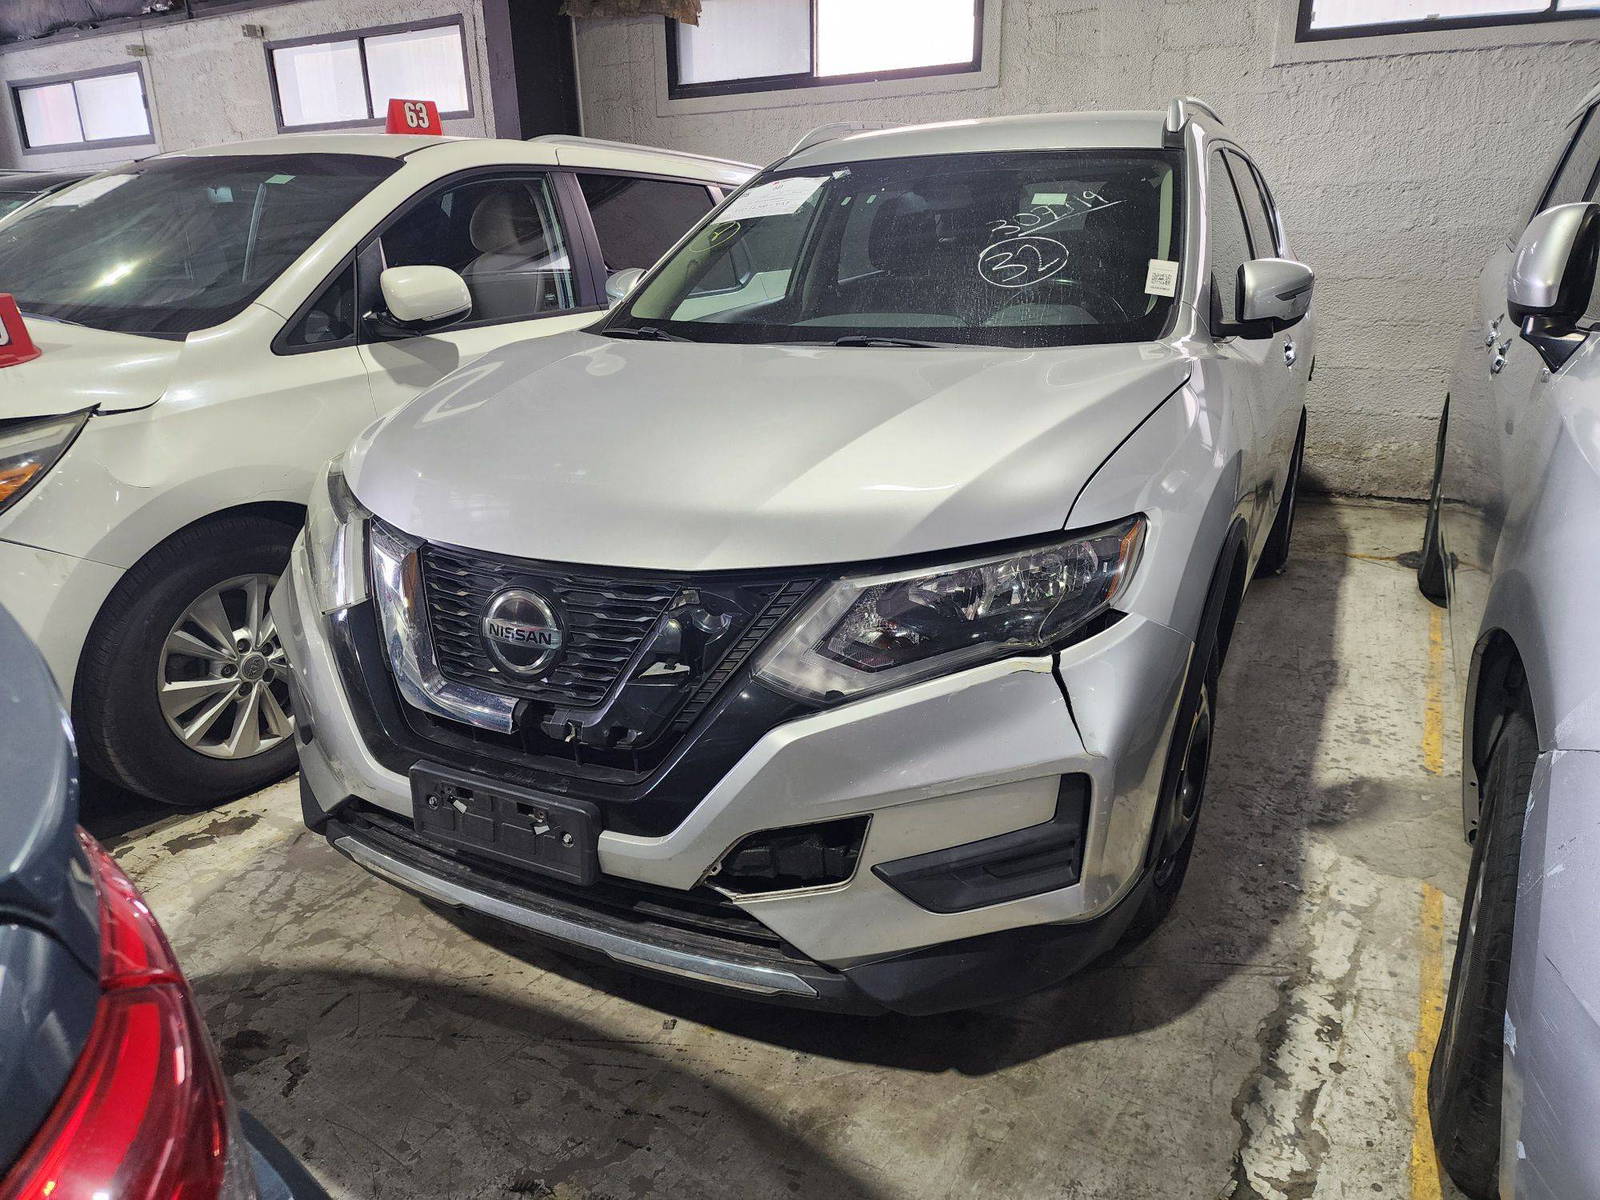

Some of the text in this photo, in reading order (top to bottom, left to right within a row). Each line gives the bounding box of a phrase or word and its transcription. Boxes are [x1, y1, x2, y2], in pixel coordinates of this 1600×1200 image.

[404, 102, 430, 128] 63
[984, 244, 1060, 283] 32
[489, 623, 552, 646] NISSAN
